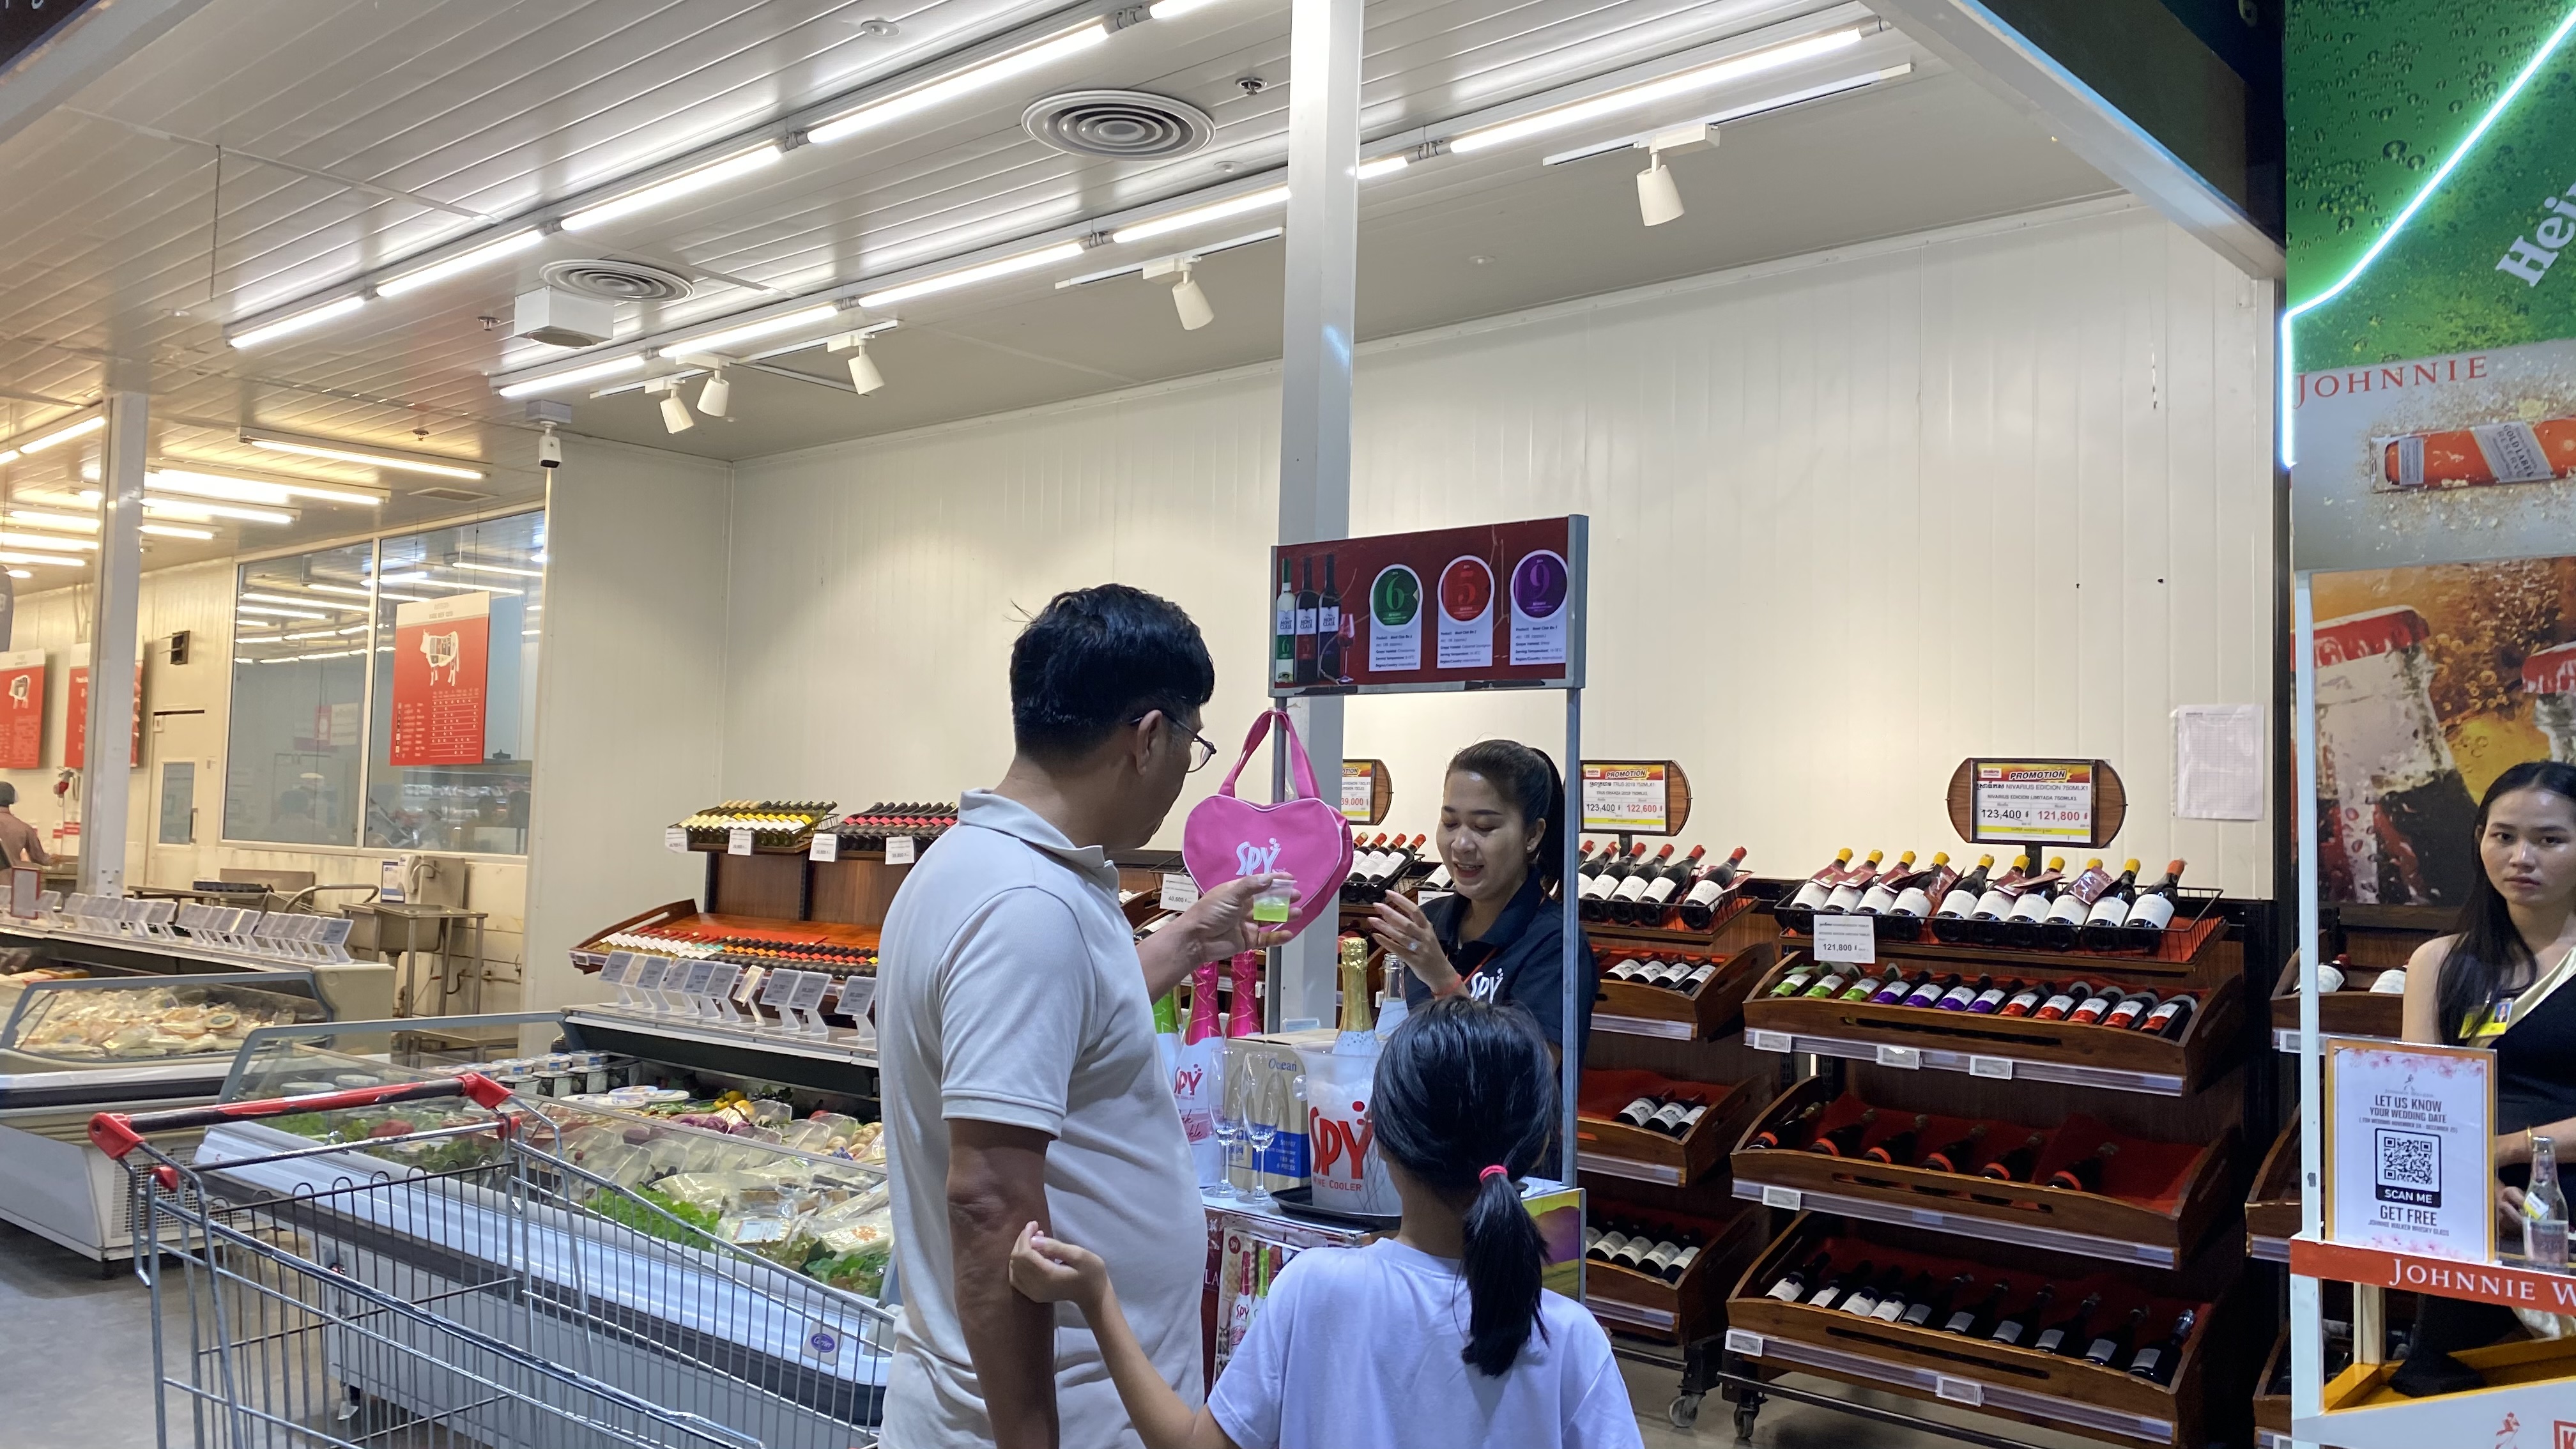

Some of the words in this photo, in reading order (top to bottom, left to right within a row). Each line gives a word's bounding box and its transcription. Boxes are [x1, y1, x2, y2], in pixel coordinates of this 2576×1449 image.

[2496, 183, 2576, 288] Hei
[2294, 356, 2487, 410] JOHNNIE
[1606, 770, 1646, 778] PROMOTION
[2010, 770, 2066, 780] PROMOTION
[1586, 803, 1616, 813] 123,400
[1627, 804, 1657, 814] 122,600
[1981, 809, 2021, 820] 123,400
[2037, 810, 2080, 822] 121,800
[1236, 840, 1282, 876] SPY
[1823, 944, 1852, 952] 121,800
[1471, 970, 1503, 1004] SPY
[2375, 1094, 2392, 1107] LET
[2395, 1096, 2408, 1109] US
[2411, 1098, 2442, 1112] KNOW
[2370, 1107, 2389, 1117] YOUR
[2391, 1109, 2426, 1121] WEDDING
[2428, 1113, 2447, 1123] DATE
[1310, 1106, 1374, 1180] SPY
[1329, 1179, 1362, 1192] COOLER
[2384, 1189, 2414, 1202] SCAN
[2416, 1193, 2433, 1204] ME
[2380, 1205, 2404, 1222] GET
[2407, 1209, 2437, 1227] FREE
[2388, 1259, 2536, 1301] JOHNNIE
